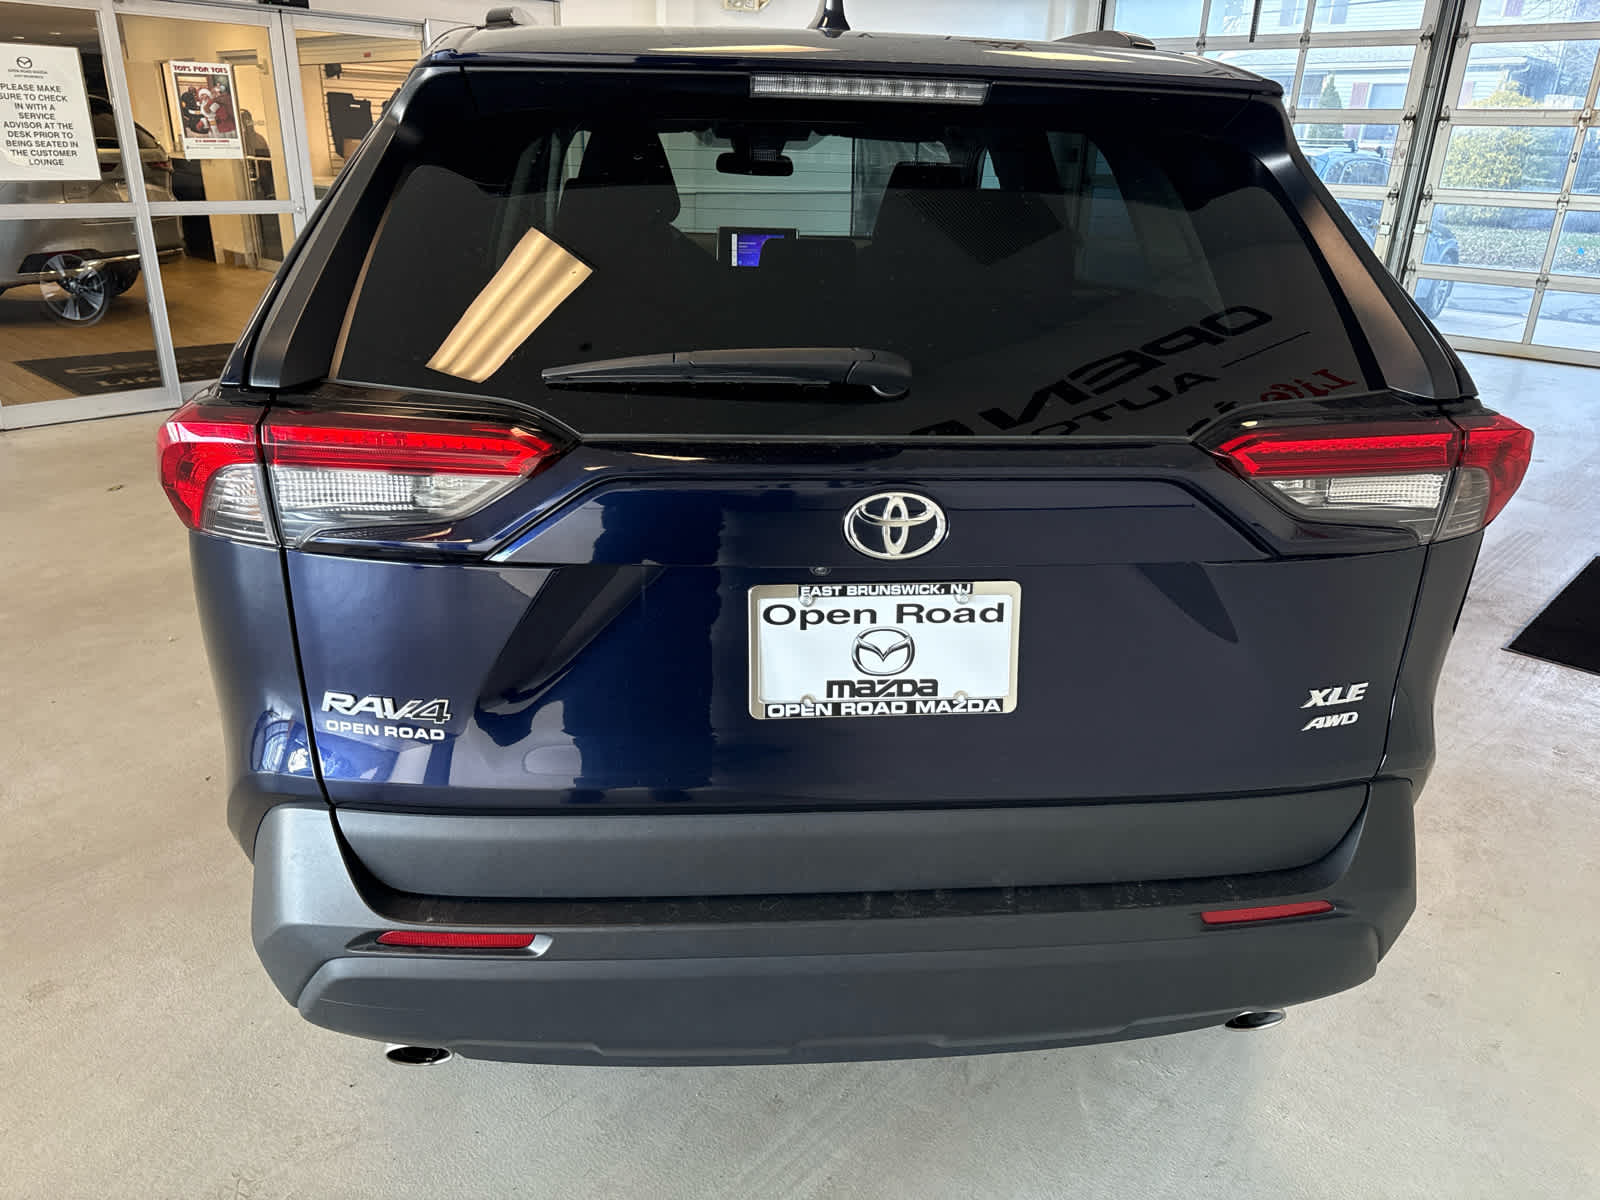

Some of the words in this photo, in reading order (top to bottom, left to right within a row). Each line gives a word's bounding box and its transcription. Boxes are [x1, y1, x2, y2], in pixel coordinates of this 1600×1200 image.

[0, 83, 35, 92] PLEASE
[36, 84, 62, 93] MAKE
[0, 92, 22, 101] SURE
[23, 93, 37, 101] TO
[38, 94, 69, 103] CHECK
[14, 102, 24, 110] IN
[25, 103, 48, 111] WITH
[18, 112, 56, 121] SERVICE
[3, 121, 43, 129] ADVISOR
[44, 122, 55, 130] AT
[56, 122, 74, 130] THE
[7, 130, 32, 138] DESK
[33, 131, 60, 139] PRIOR
[61, 132, 74, 140] TO
[6, 139, 33, 148] BEING
[34, 140, 69, 148] SEATED
[70, 141, 79, 149] IN
[10, 149, 28, 157] THE
[30, 149, 78, 157] CUSTOMER
[28, 158, 65, 166] LOUNGE
[800, 585, 843, 597] EAST
[846, 583, 946, 597] BRUNSWICK,
[950, 583, 973, 595] NJ
[762, 603, 878, 631] Open
[895, 602, 1005, 624] Road
[1300, 682, 1369, 709] XLE
[321, 690, 452, 725] RAV4
[766, 702, 834, 718] OPEN
[840, 700, 908, 717] ROAD
[915, 698, 1002, 714] MAZDA
[1300, 711, 1359, 732] AWD
[325, 719, 380, 737] OPEN
[383, 725, 446, 741] ROAD
